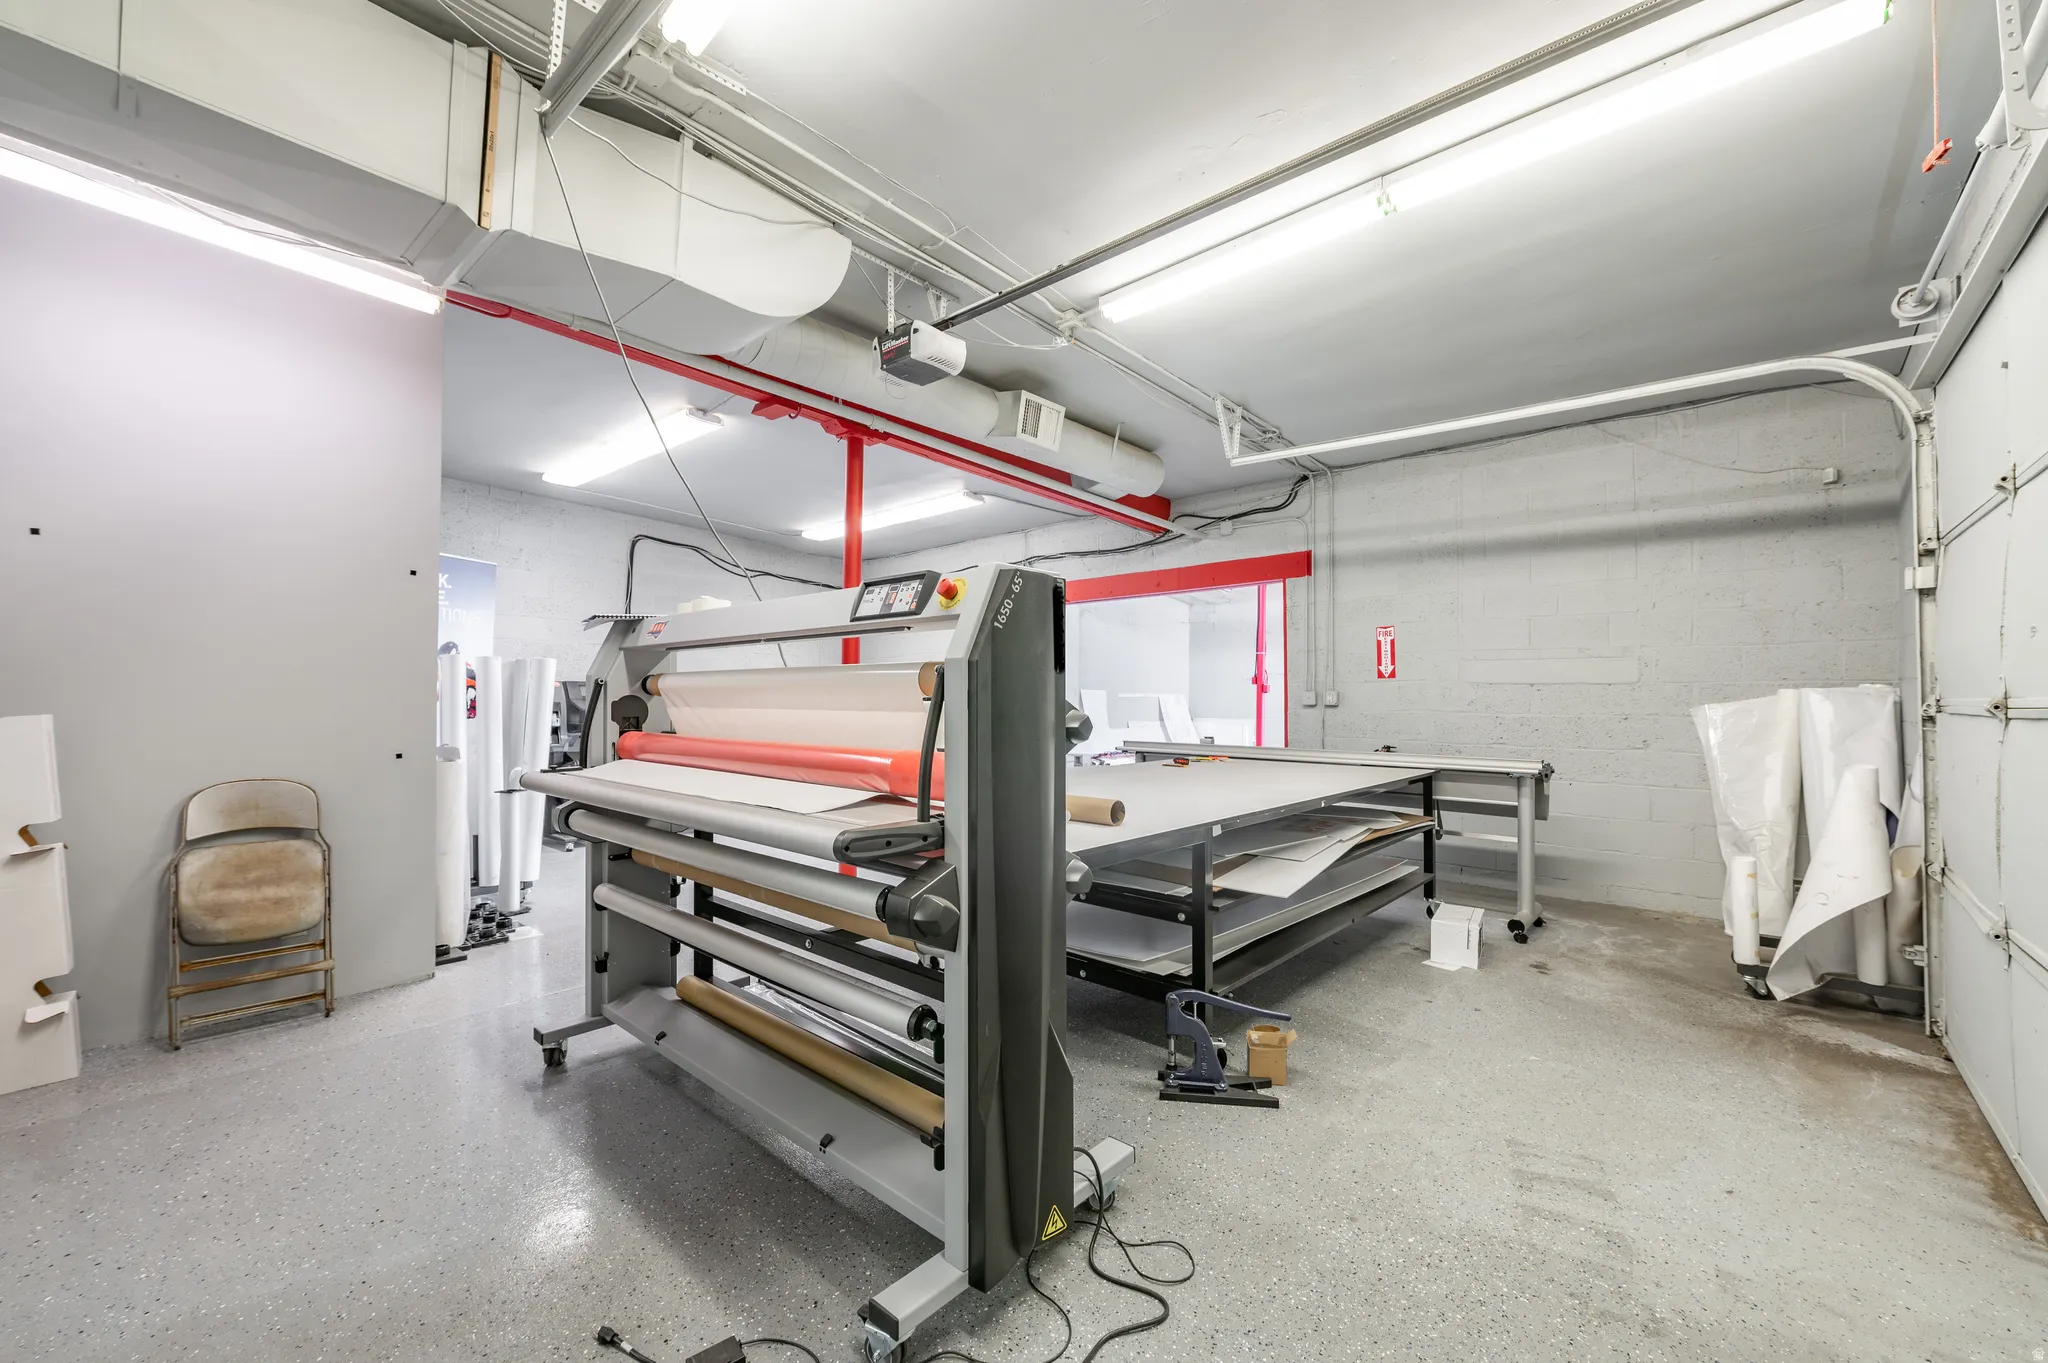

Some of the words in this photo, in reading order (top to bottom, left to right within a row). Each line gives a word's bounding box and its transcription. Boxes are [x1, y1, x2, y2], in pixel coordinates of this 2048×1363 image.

[438, 572, 452, 589] K.
[993, 599, 1014, 629] 1650
[1011, 571, 1023, 593] 65"
[439, 606, 482, 625] TIONS
[1378, 630, 1393, 638] FIRE
